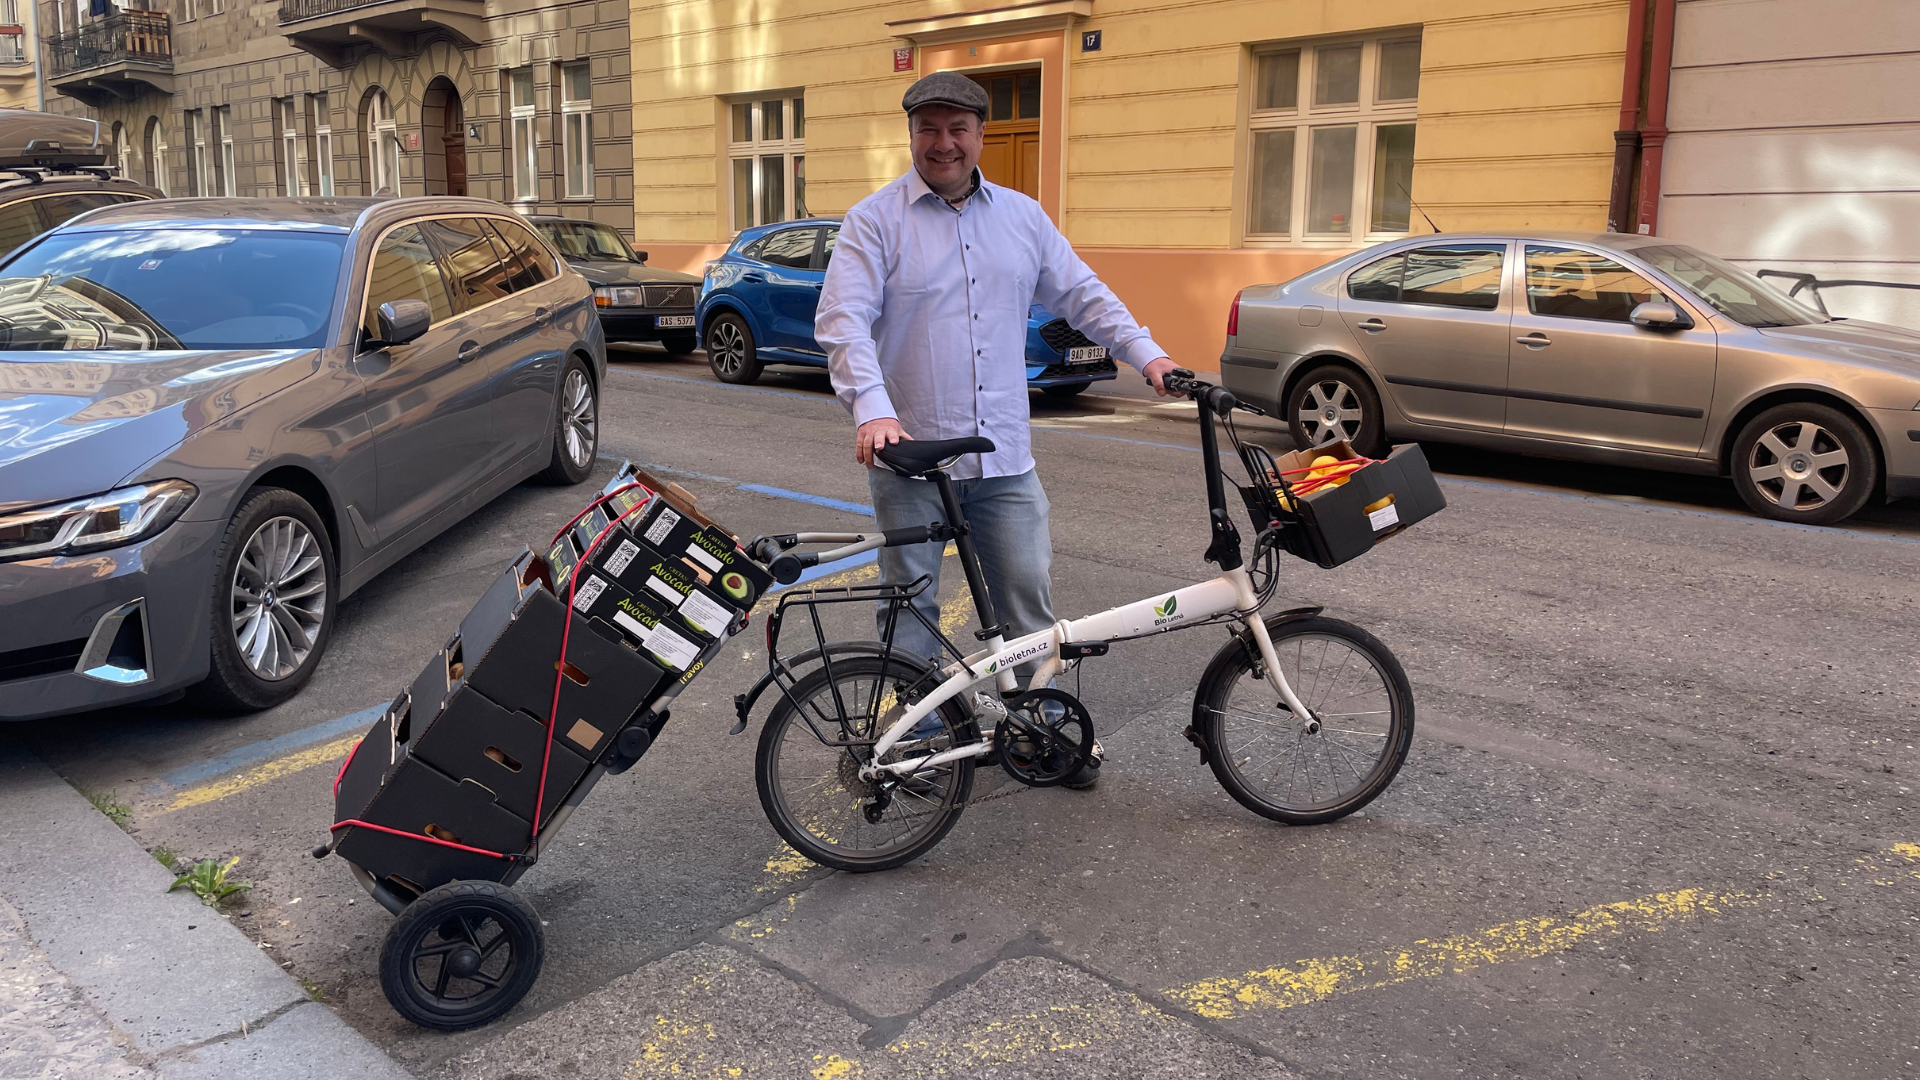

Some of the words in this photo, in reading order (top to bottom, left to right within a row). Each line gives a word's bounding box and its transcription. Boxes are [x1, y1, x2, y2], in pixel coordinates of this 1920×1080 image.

[1086, 35, 1096, 47] 17
[660, 317, 673, 326] 6AS
[677, 316, 694, 326] 5377
[1071, 349, 1084, 361] 9AD
[1087, 347, 1104, 359] 8132
[690, 531, 735, 565] Avocado
[617, 598, 661, 629] Avocad
[999, 641, 1048, 667] bioletna.cz
[678, 658, 704, 685] Travoy
